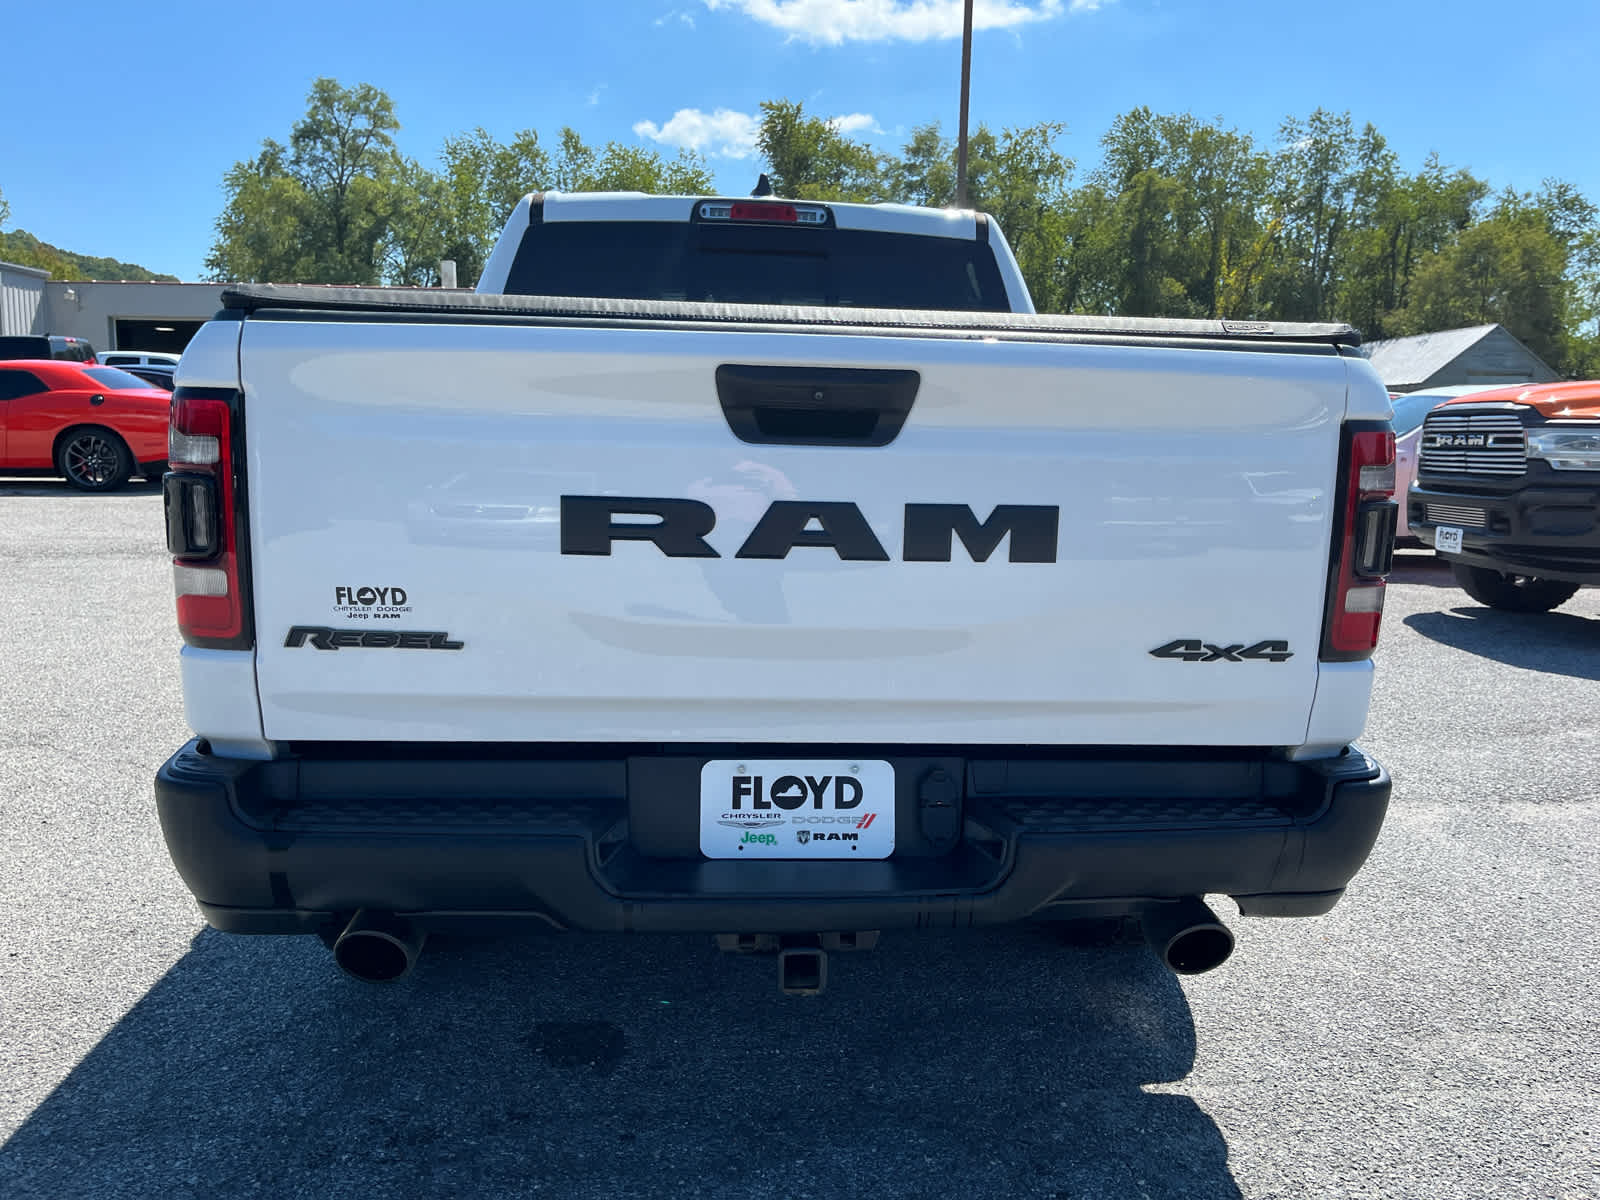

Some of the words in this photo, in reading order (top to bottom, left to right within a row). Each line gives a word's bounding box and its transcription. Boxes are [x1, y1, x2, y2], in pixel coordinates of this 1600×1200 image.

[1438, 433, 1484, 447] RAM
[561, 495, 1060, 562] RAM
[336, 586, 407, 606] FLOYD
[283, 626, 465, 651] REBEL
[1149, 639, 1294, 662] 4x4
[732, 775, 863, 810] FLOYD
[792, 816, 865, 824] DODGE
[741, 831, 777, 845] Jeep
